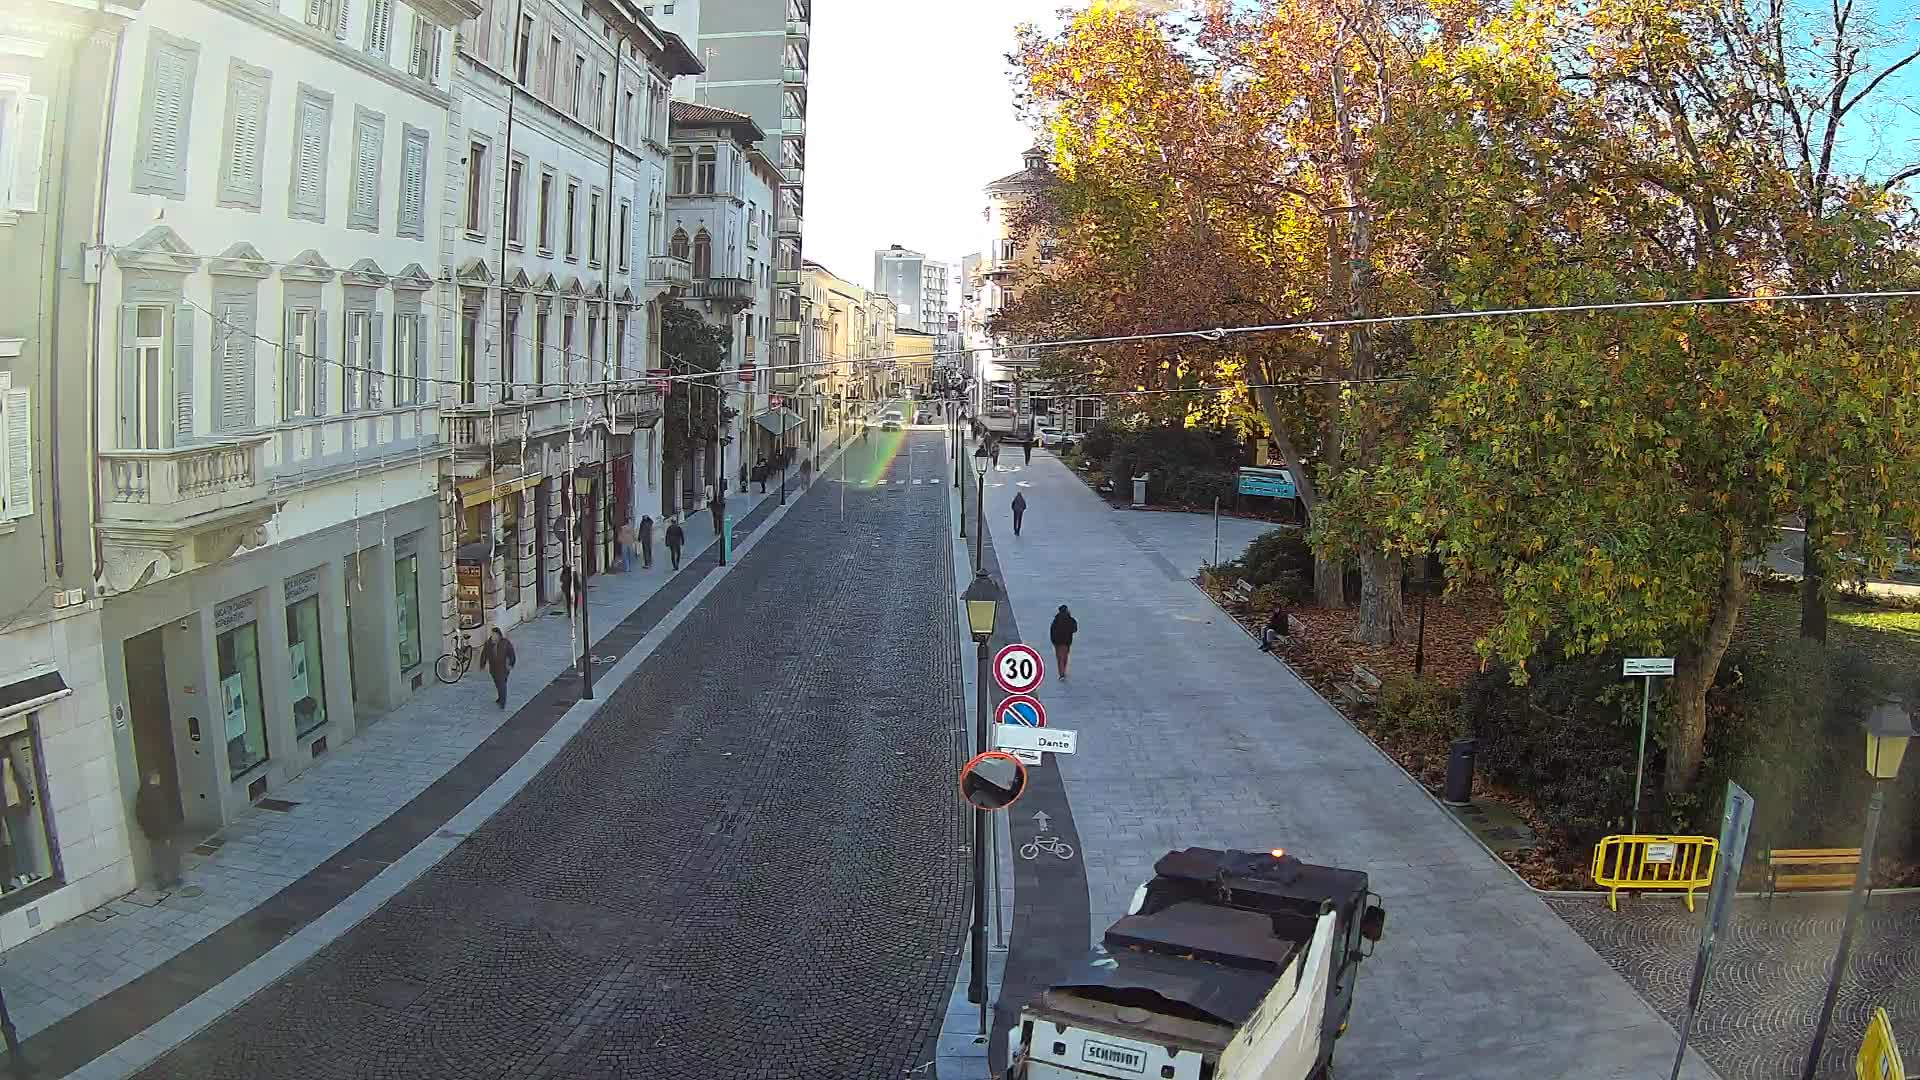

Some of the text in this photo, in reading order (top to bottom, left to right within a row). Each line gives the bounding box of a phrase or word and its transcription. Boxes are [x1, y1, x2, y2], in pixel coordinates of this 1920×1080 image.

[1005, 658, 1033, 680] 30
[1038, 737, 1070, 749] Dante
[1089, 1046, 1140, 1067] SCHMIDT
